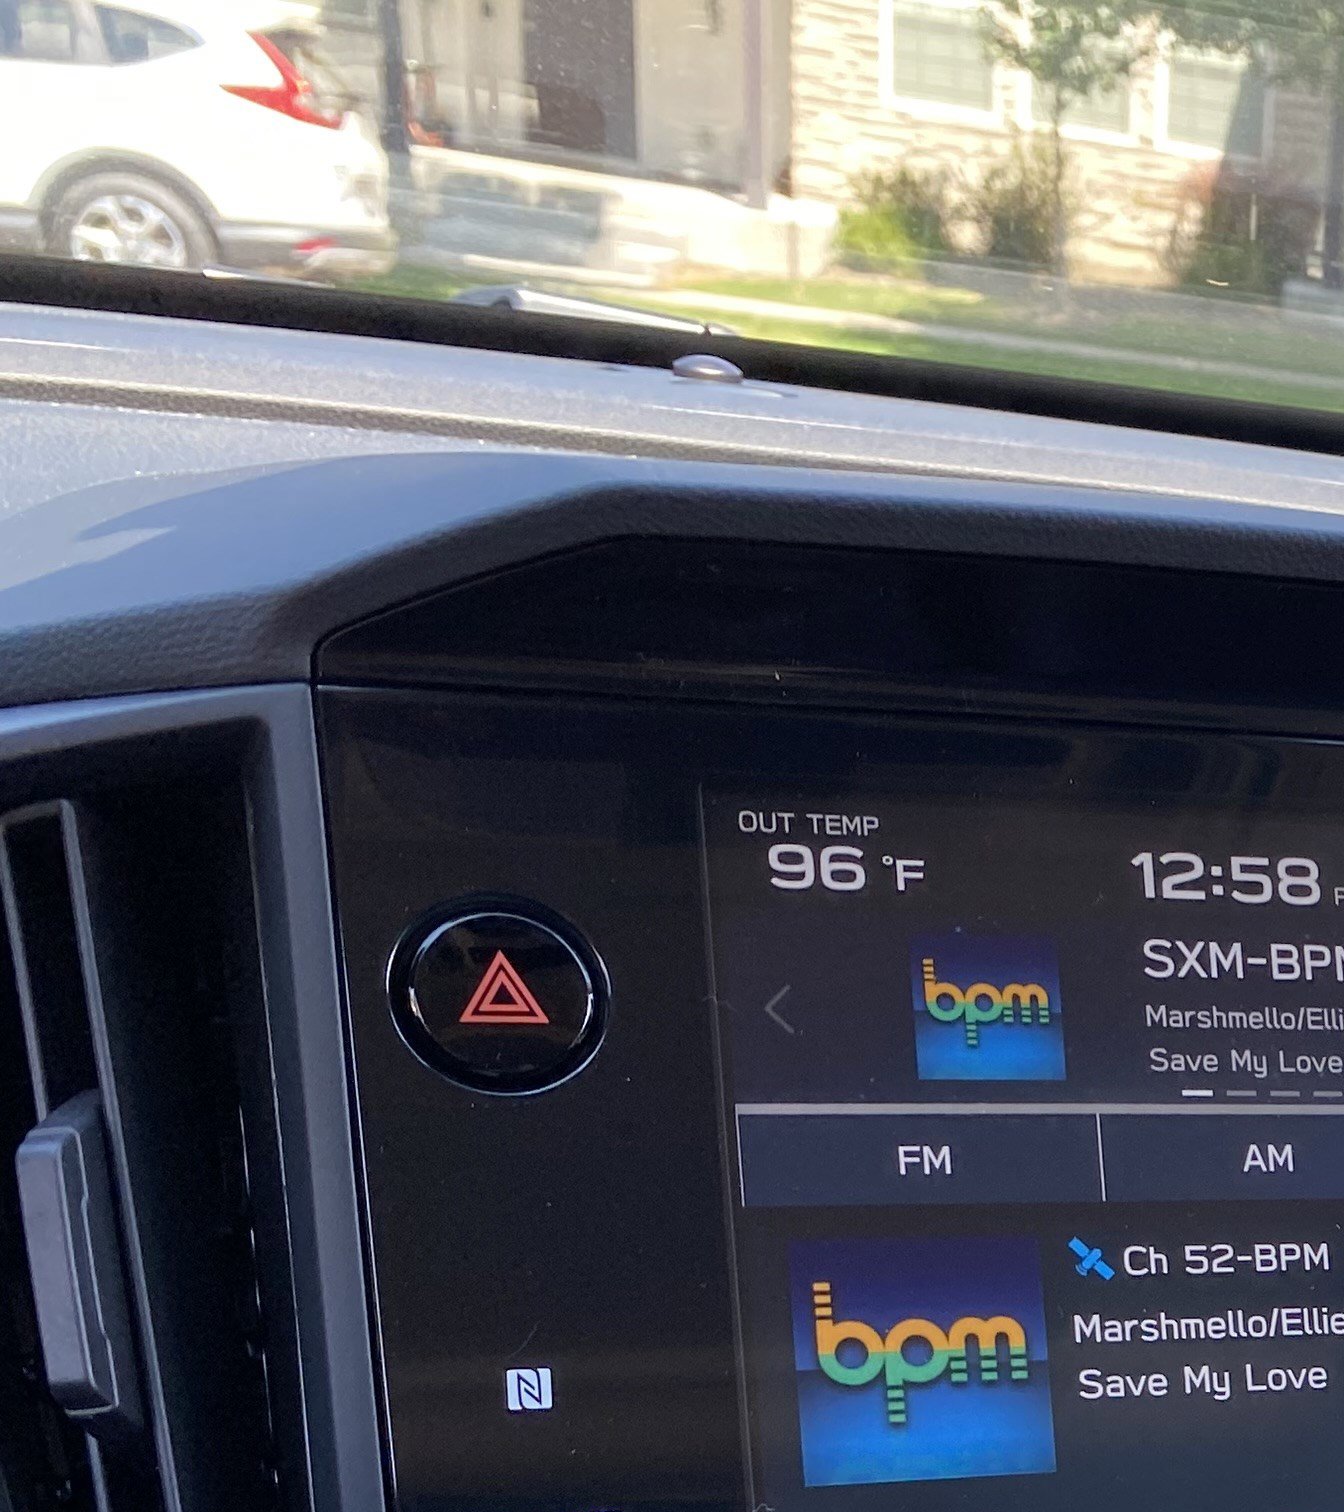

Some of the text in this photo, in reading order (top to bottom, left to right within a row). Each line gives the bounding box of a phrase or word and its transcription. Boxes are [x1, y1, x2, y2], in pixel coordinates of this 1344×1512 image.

[738, 810, 880, 837] OUT TEMP
[768, 843, 866, 891] 96
[1130, 852, 1321, 906] 12:58
[1149, 1047, 1344, 1079] Save My Love
[898, 1145, 952, 1176] FM
[1243, 1143, 1294, 1173] AM
[1123, 1242, 1330, 1276] Ch 52-BPM
[1078, 1363, 1328, 1401] Save My Love
